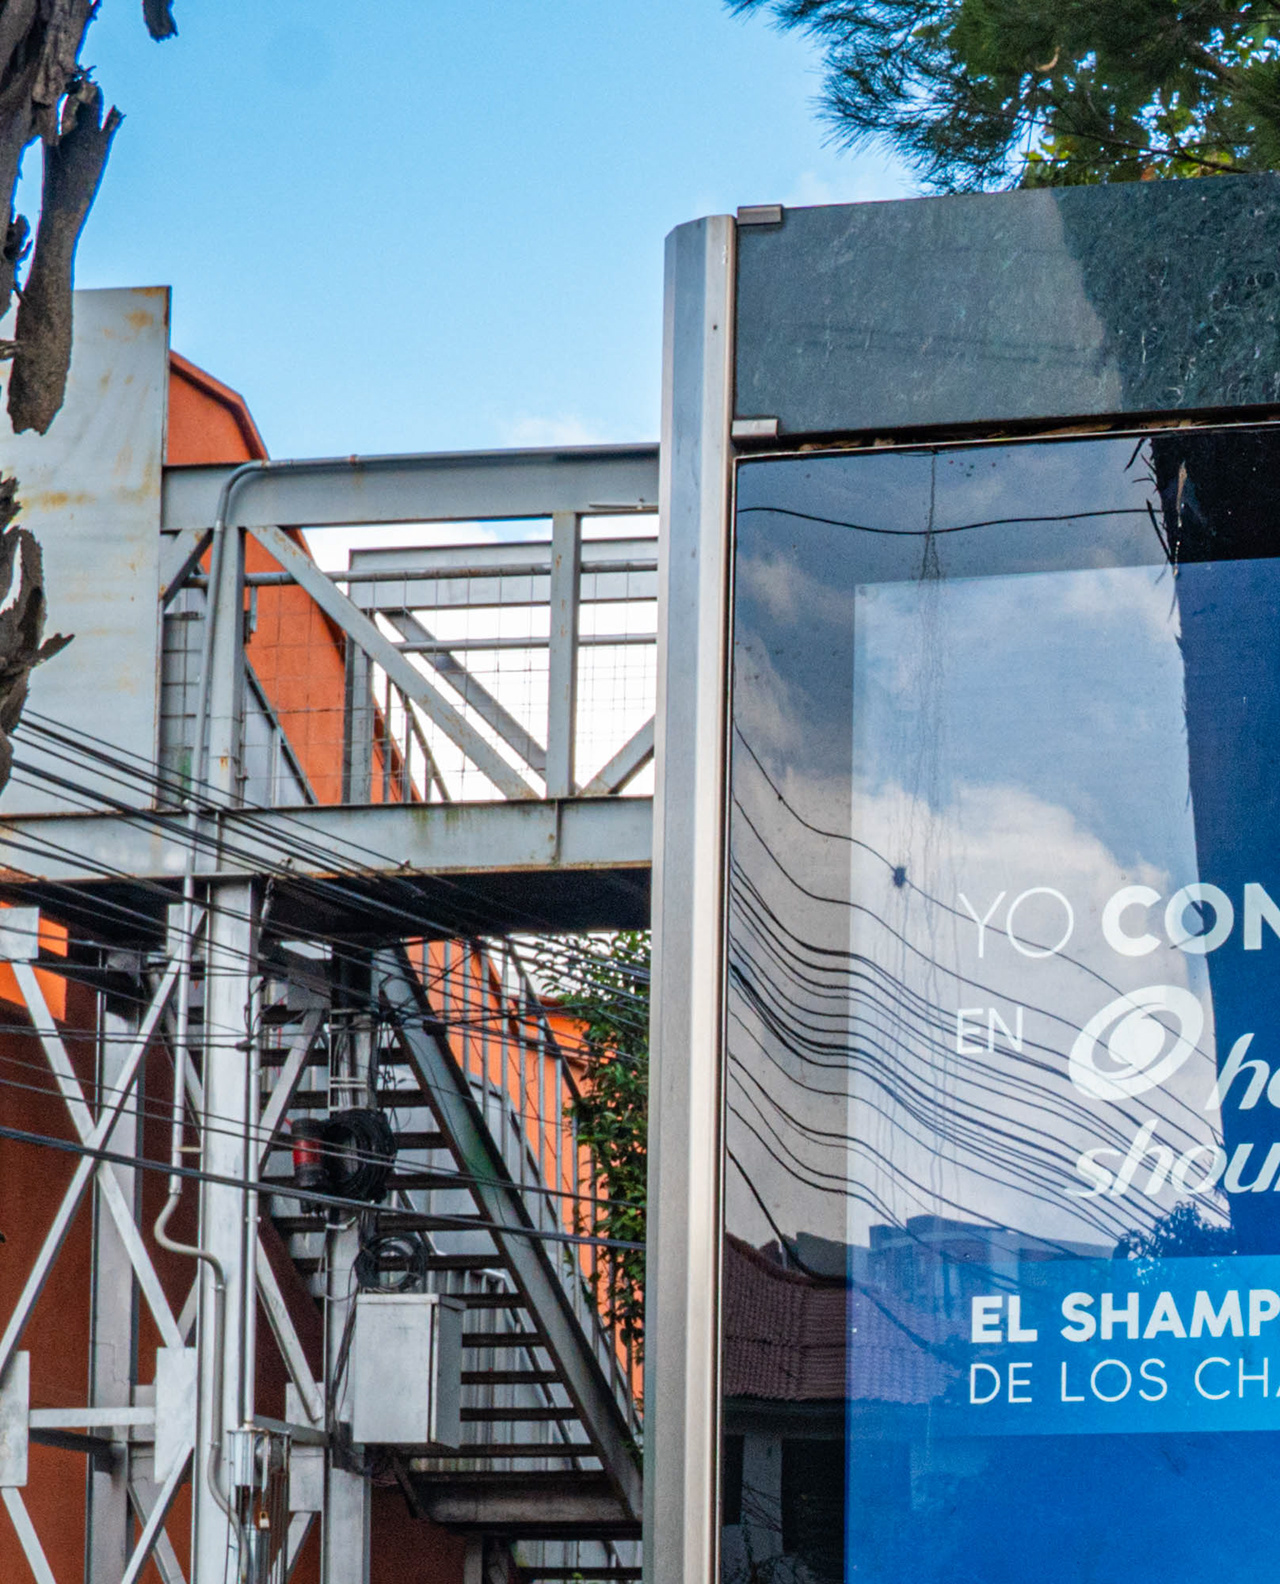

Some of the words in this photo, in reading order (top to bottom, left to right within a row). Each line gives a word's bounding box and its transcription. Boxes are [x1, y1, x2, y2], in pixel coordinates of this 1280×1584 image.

[957, 886, 1075, 959] YO
[955, 1006, 1023, 1055] EN
[971, 1295, 1037, 1344] EL
[969, 1362, 1032, 1404] DE
[1060, 1358, 1168, 1402] LOS
